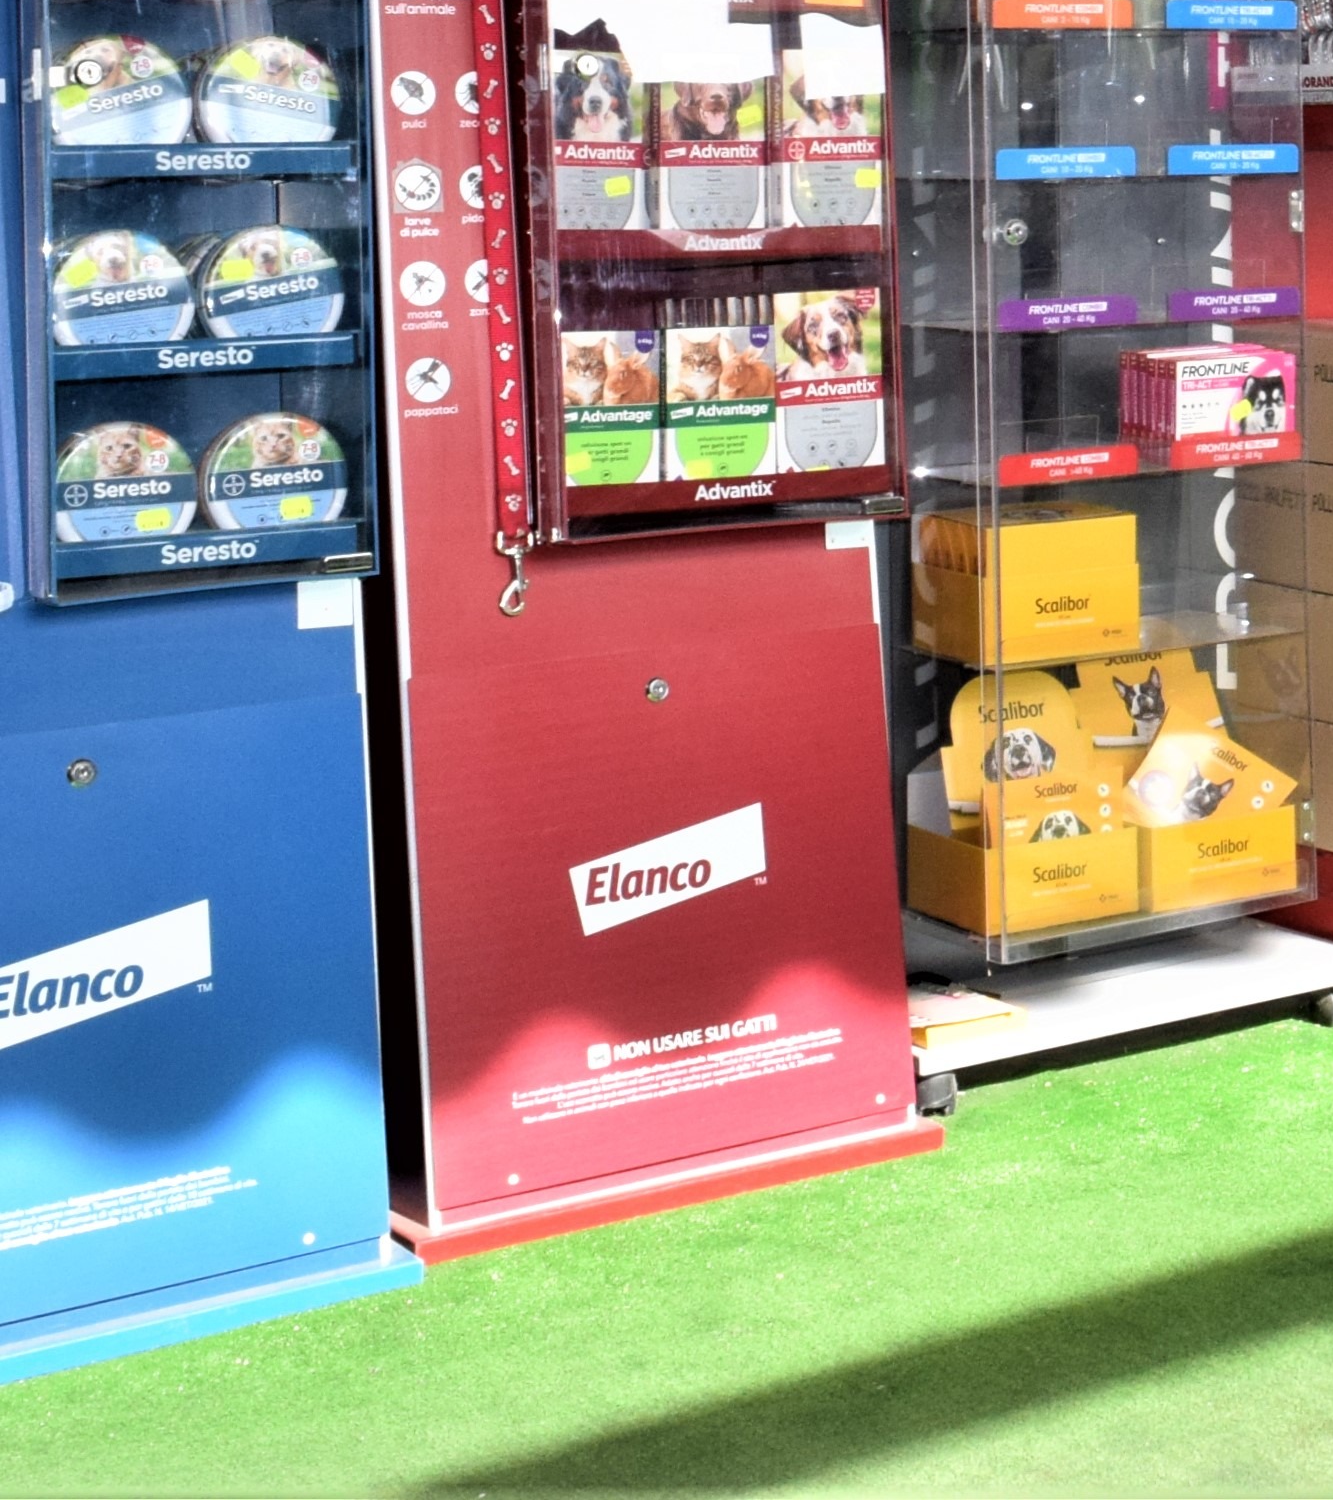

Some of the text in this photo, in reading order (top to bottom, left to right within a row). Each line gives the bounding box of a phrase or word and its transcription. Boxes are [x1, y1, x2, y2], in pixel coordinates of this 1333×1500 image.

[384, 3, 456, 16] sull'animale
[88, 81, 163, 114] Seresto
[401, 117, 427, 131] pulci
[564, 144, 636, 161] Advantix
[688, 143, 760, 160] Advantix
[808, 139, 876, 155] Advantix
[1192, 150, 1241, 161] FRONTLINE
[155, 150, 251, 172] Seresto
[684, 233, 764, 251] Advantix
[89, 282, 168, 308] Seresto
[245, 275, 319, 302] Seresto
[1028, 303, 1079, 315] FRONTLINE
[1193, 295, 1242, 306] FRONTLINE
[407, 310, 443, 321] mosca
[157, 346, 254, 369] Seresto
[1181, 361, 1250, 378] FRONTLINE
[804, 379, 877, 397] Advantix
[404, 405, 459, 419] pappataci
[580, 408, 653, 425] Advantage
[695, 403, 769, 419] Advantage
[1030, 454, 1080, 468] FRONTLINE
[250, 467, 324, 488] Seresto
[92, 478, 172, 499] Seresto
[694, 480, 774, 502] Advantix
[160, 541, 258, 564] Seresto
[1035, 596, 1090, 614] Scalibor
[1034, 781, 1078, 798] Scalibor
[1197, 838, 1249, 859] Scalibor
[1032, 863, 1087, 883] Scalibor
[584, 857, 714, 909] Elanco
[613, 1013, 778, 1062] NON USARE SUI GATTI
